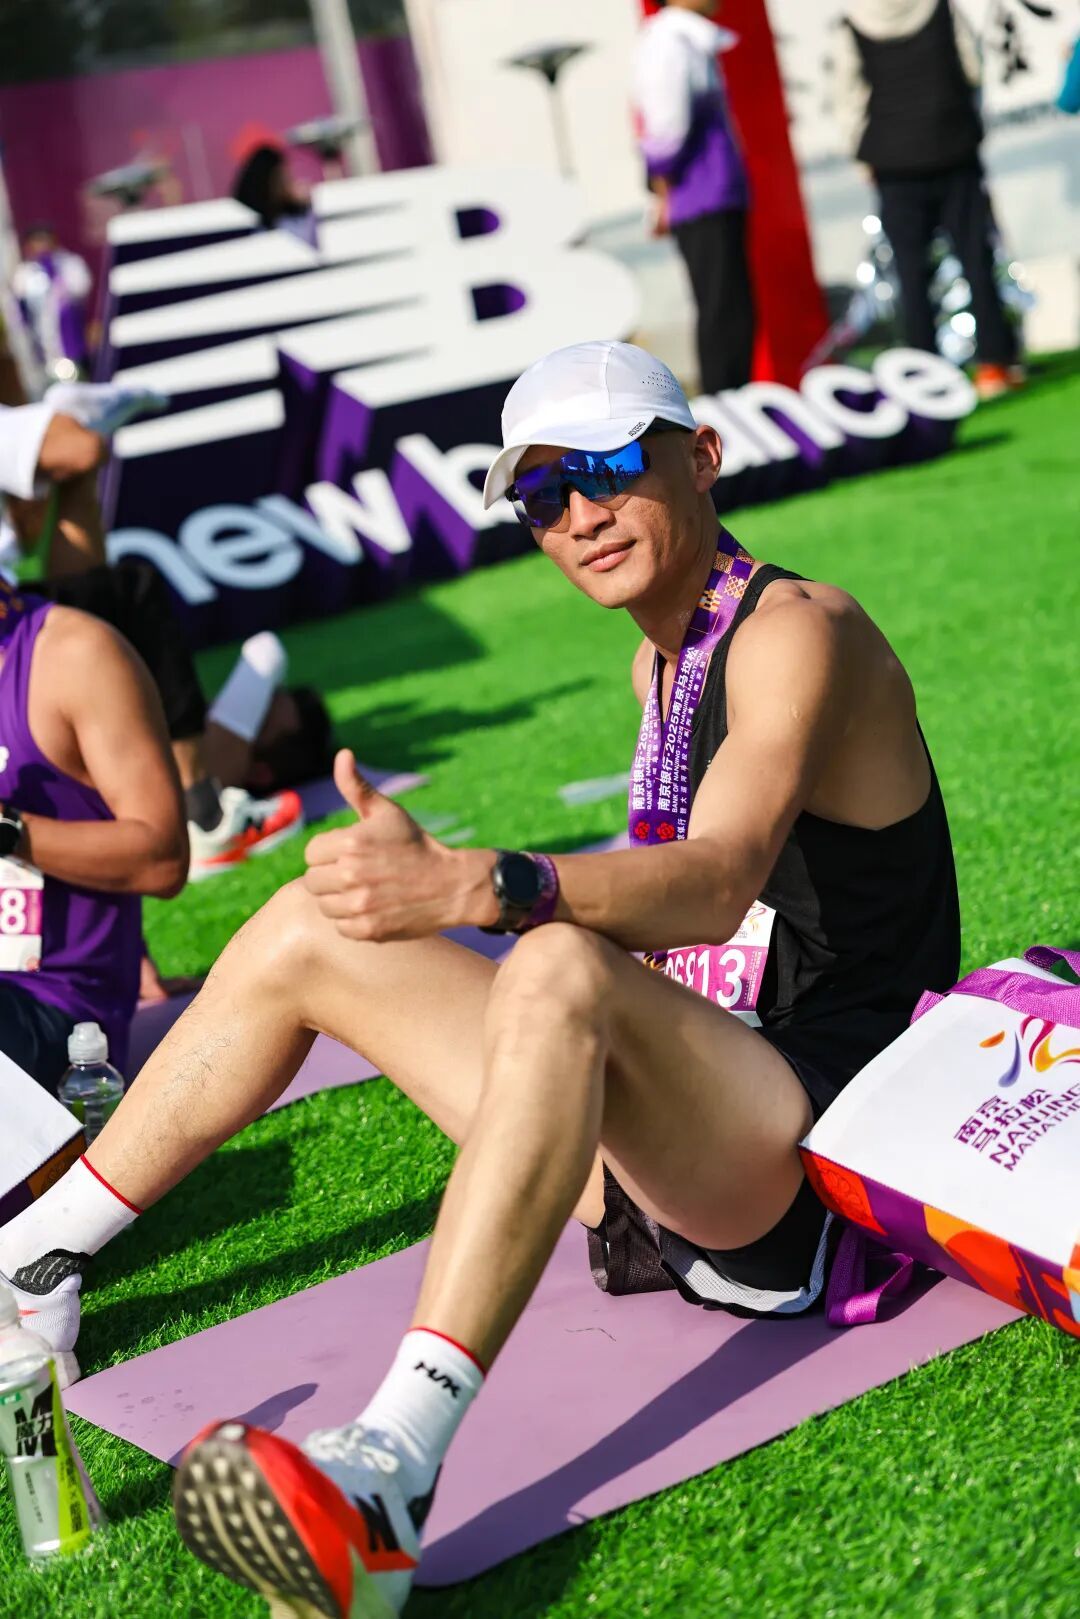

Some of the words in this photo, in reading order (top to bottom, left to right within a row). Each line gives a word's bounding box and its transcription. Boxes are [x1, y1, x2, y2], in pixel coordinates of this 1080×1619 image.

[106, 466, 412, 604] new
[395, 347, 978, 531] bance
[687, 650, 705, 691] MARATHON
[673, 750, 681, 782] NANJING
[671, 794, 679, 813] BANK
[673, 783, 680, 793] OF
[954, 1095, 1009, 1143] 南京
[971, 1088, 1052, 1152] 马拉松
